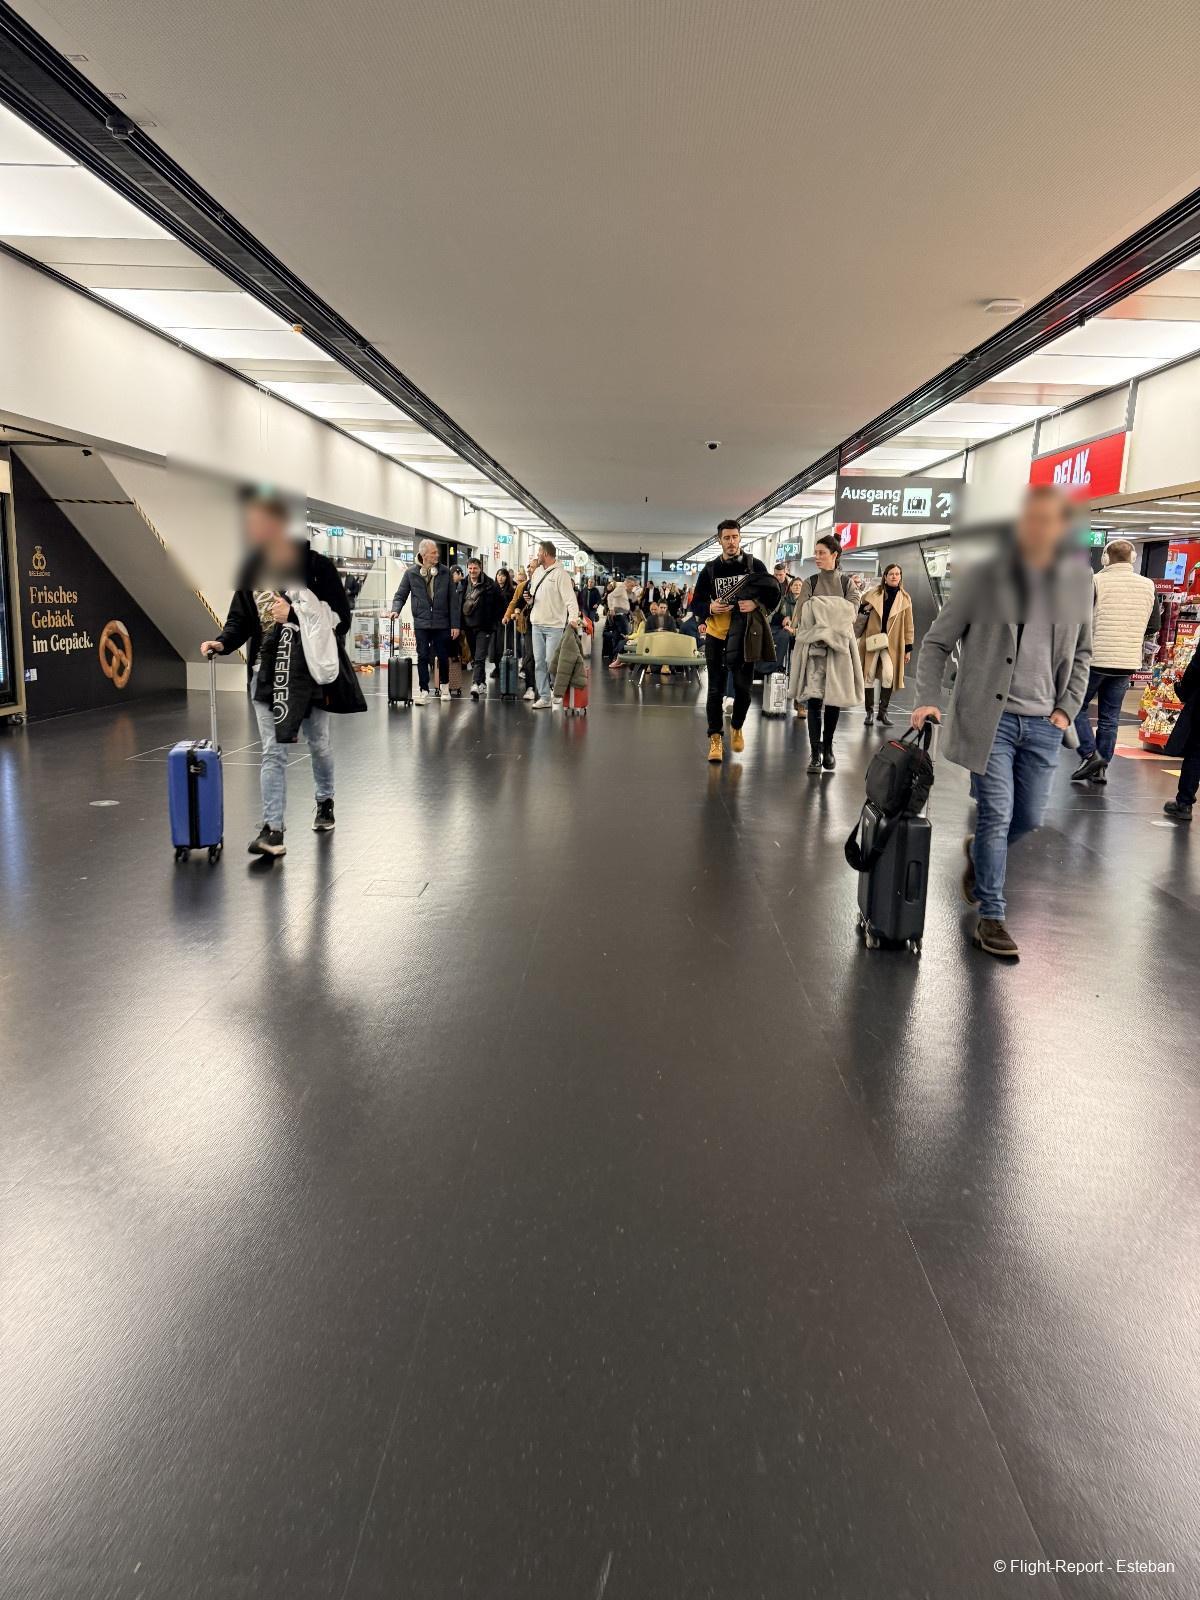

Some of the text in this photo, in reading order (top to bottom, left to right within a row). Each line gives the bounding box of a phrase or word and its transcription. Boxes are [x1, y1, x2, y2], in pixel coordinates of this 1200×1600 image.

[841, 487, 901, 503] Ausgang
[871, 503, 898, 516] Exit
[29, 585, 78, 604] Frisches
[31, 609, 75, 629] Gebäck
[32, 631, 94, 655] im Gepäck.
